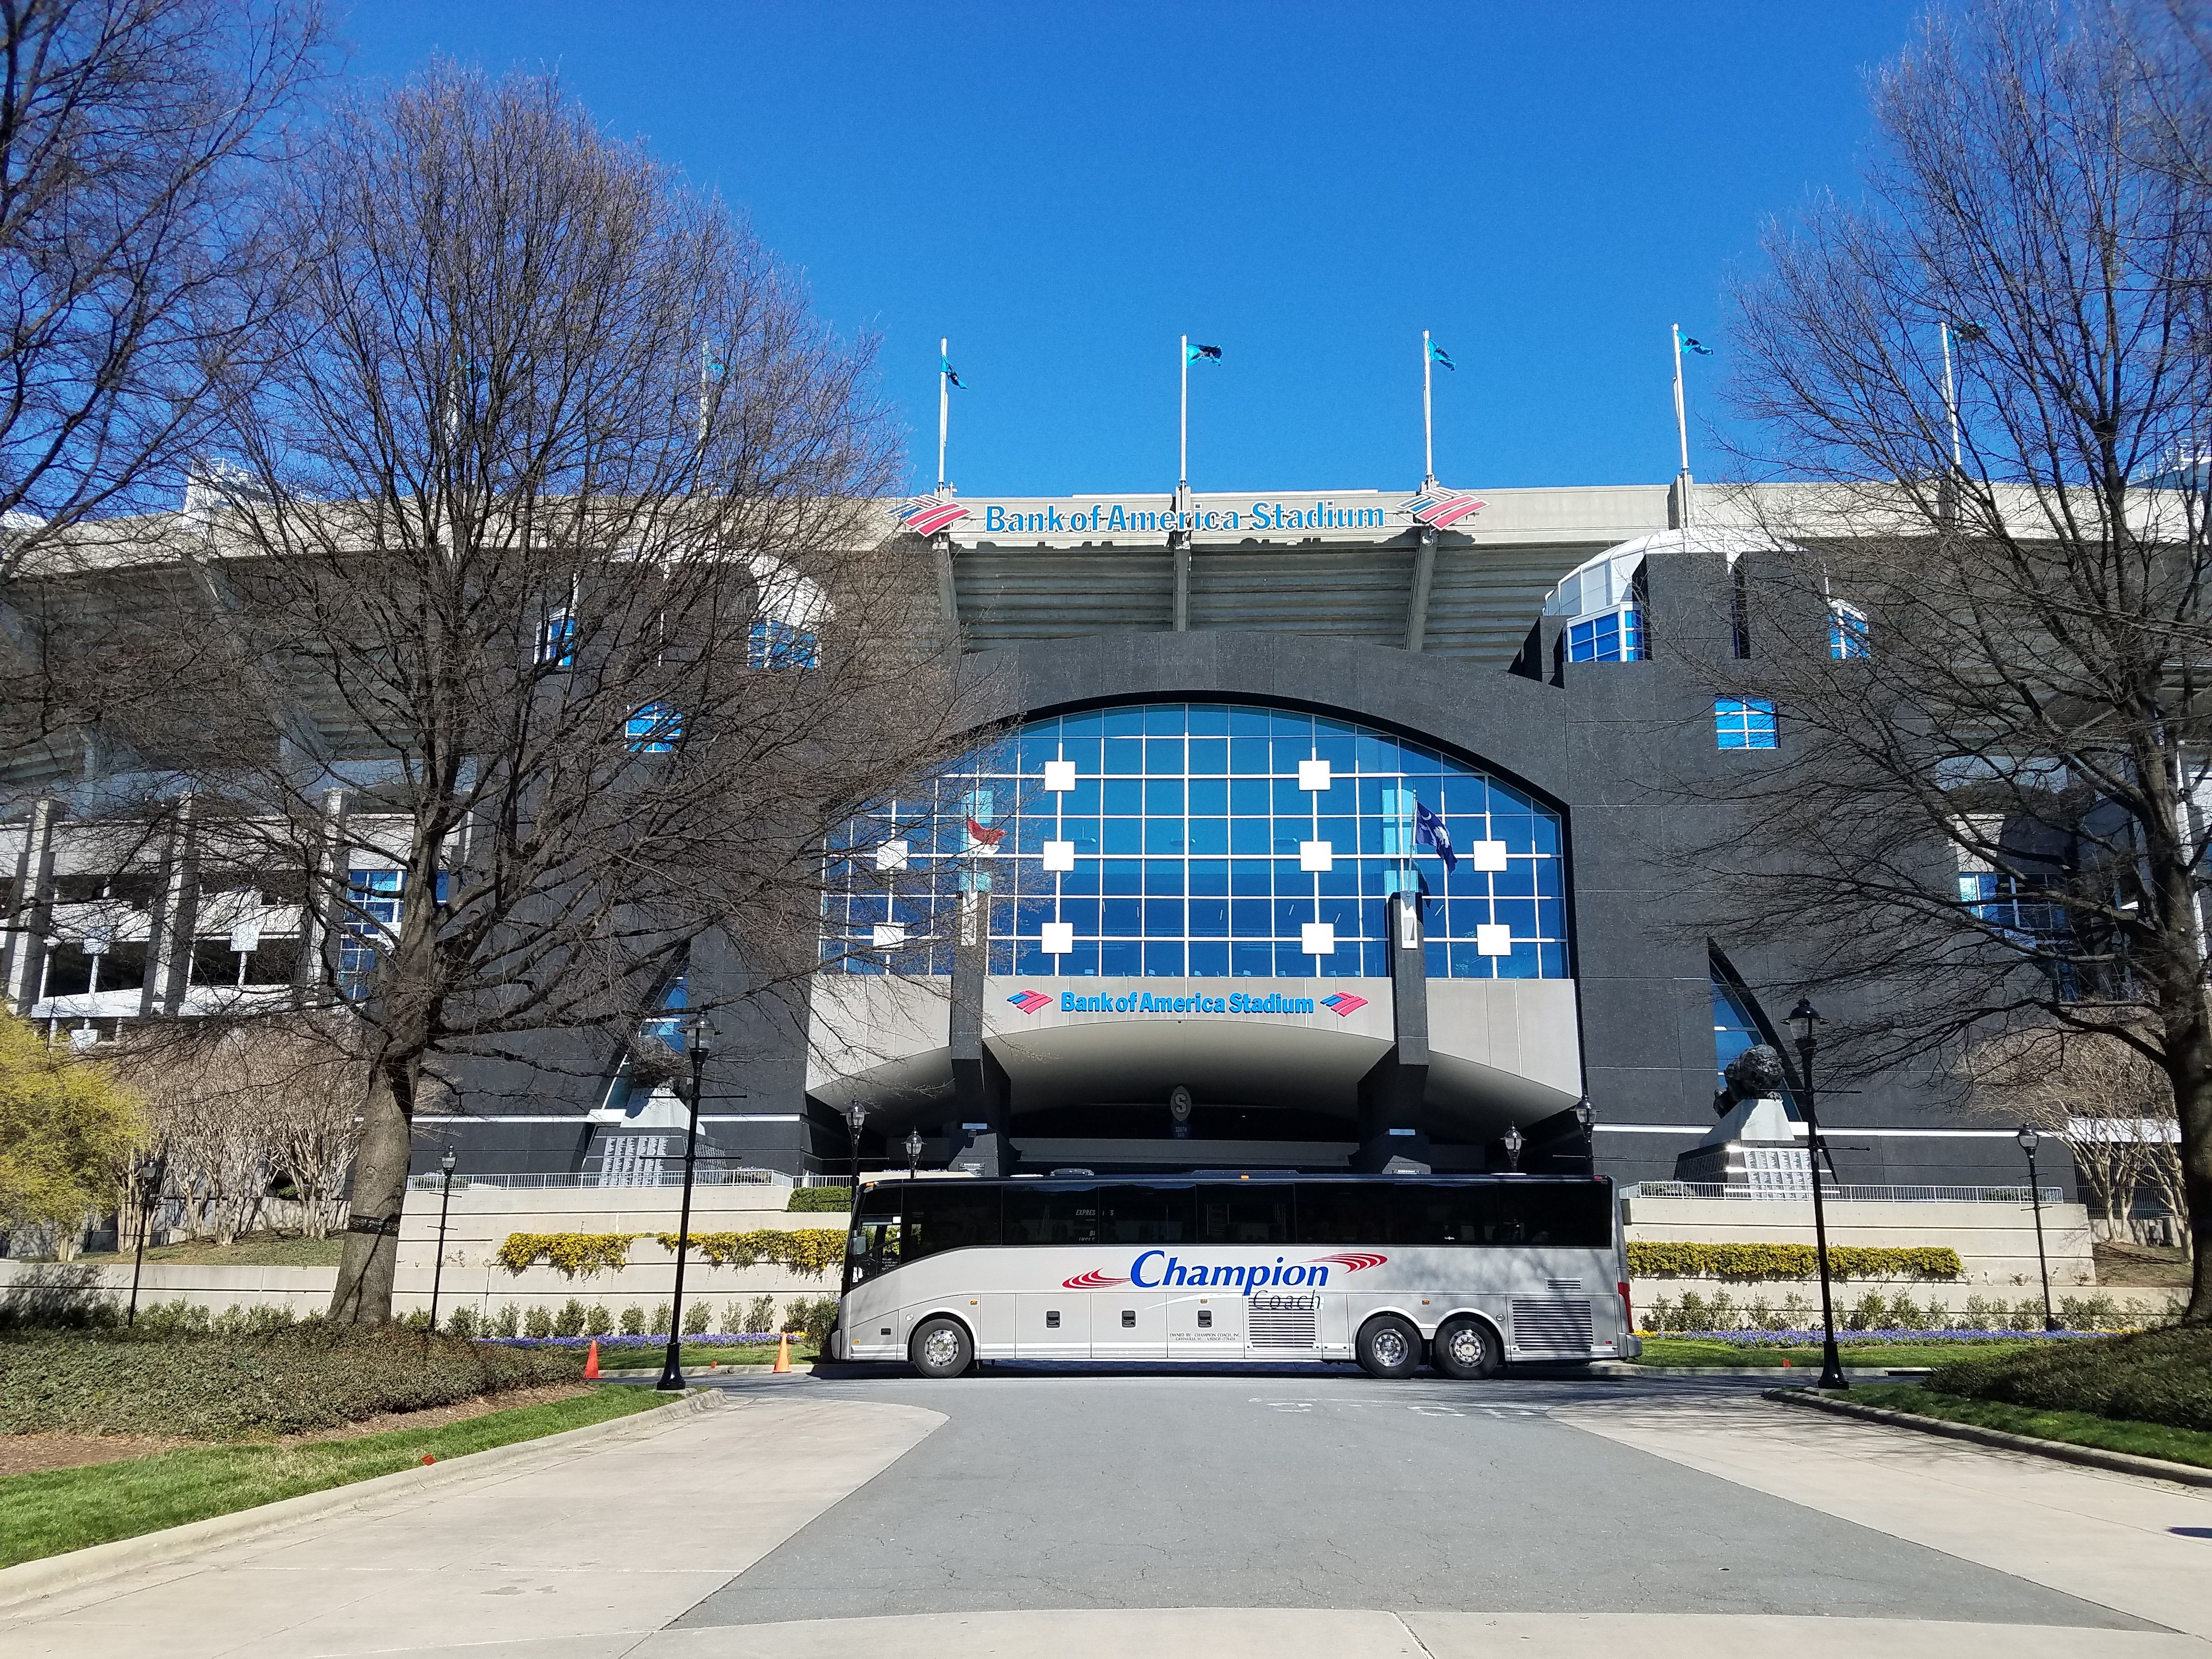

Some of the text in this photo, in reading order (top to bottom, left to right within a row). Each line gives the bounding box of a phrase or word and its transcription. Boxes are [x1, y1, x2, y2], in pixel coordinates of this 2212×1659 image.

[986, 501, 1384, 532] Bank of America Stadium
[1061, 991, 1314, 1014] Bank of America Stadium
[1175, 1093, 1187, 1113] S
[1130, 1250, 1329, 1296] Champion
[1253, 1289, 1321, 1310] Coach
